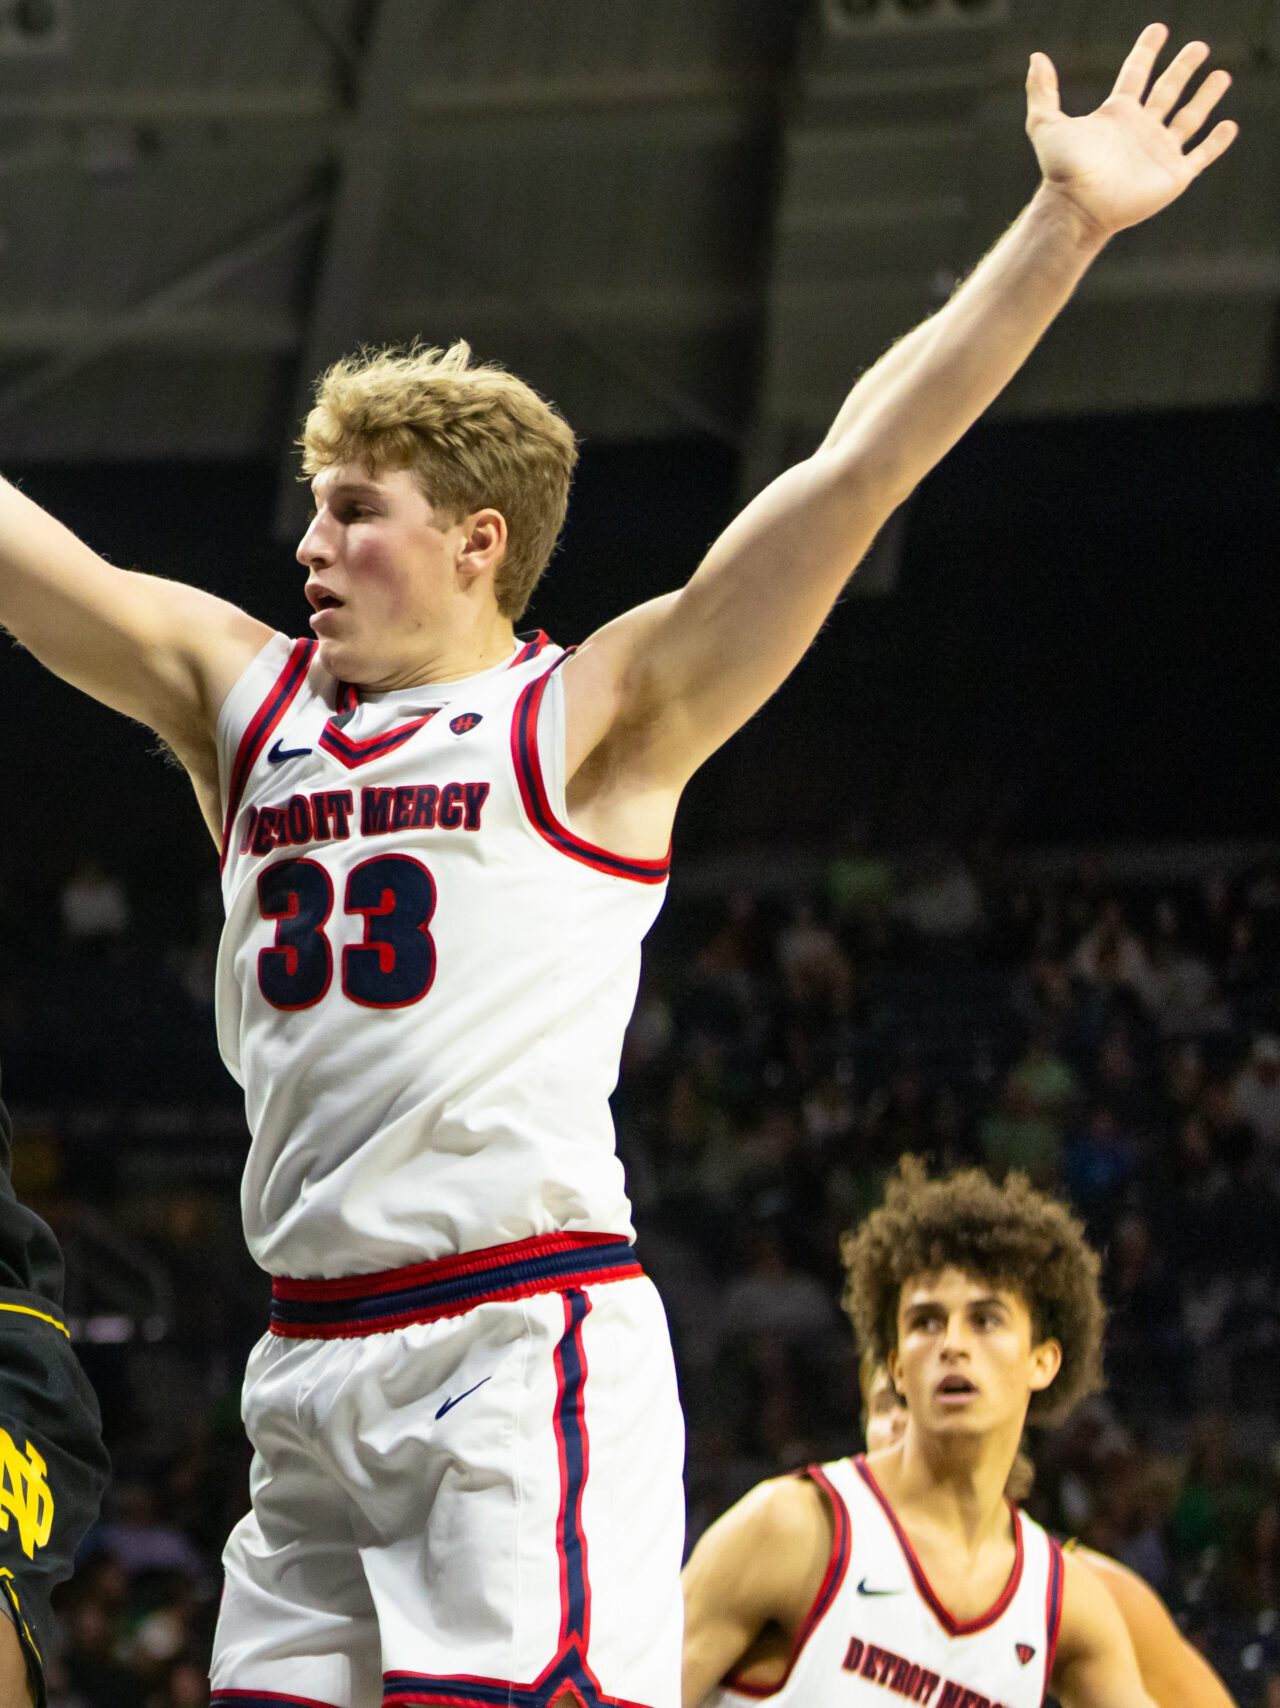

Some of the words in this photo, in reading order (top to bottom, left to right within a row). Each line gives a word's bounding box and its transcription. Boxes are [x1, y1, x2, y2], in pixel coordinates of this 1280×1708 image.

[239, 789, 355, 857] DEOIT
[361, 782, 491, 837] MERCY
[257, 853, 438, 1012] 33
[841, 1636, 941, 1706] DETROIT
